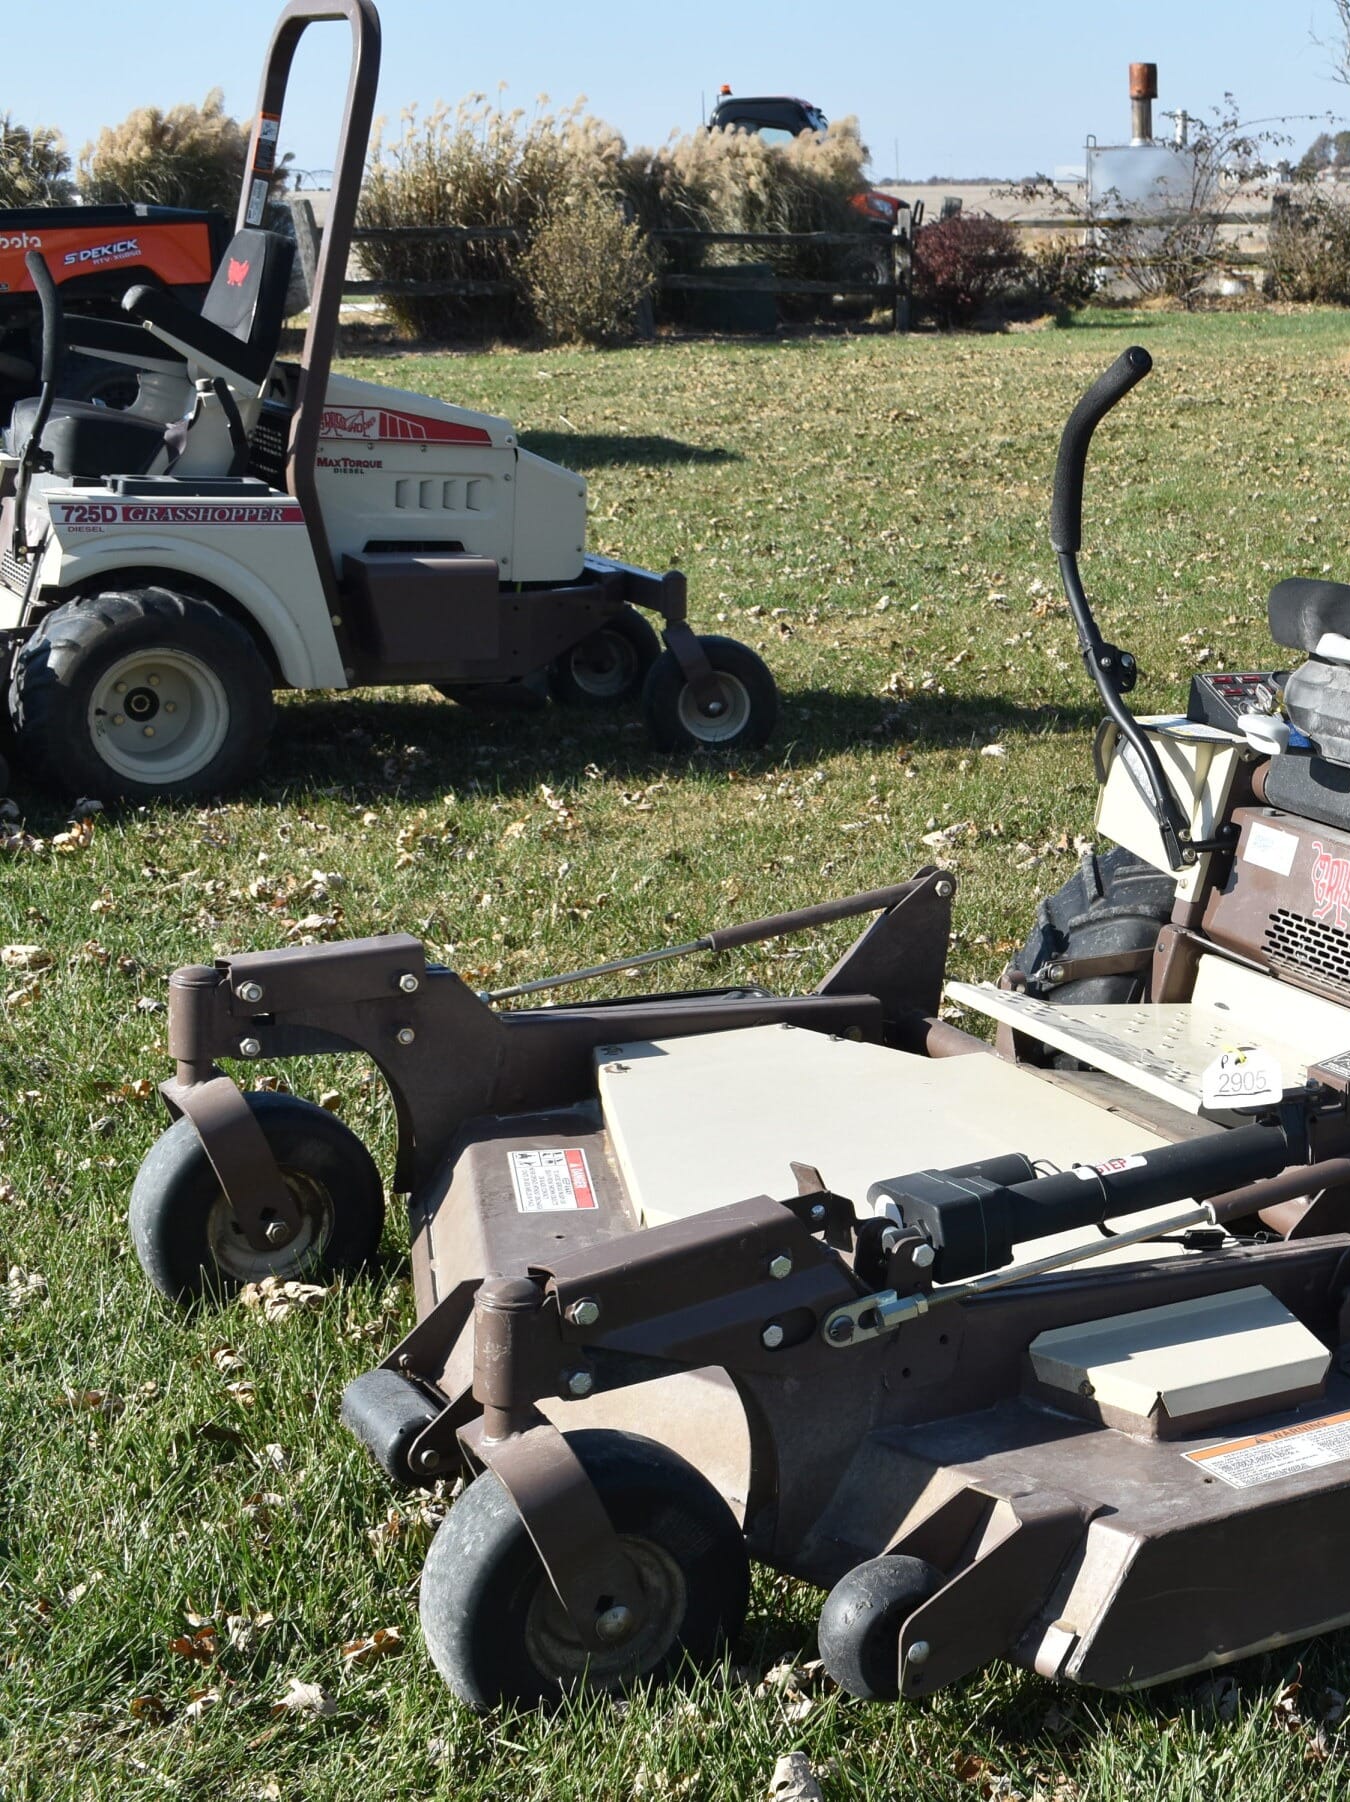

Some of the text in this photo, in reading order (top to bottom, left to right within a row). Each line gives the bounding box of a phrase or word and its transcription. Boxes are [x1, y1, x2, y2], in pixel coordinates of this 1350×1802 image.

[0, 232, 41, 249] bota
[64, 239, 138, 265] SDEKICK
[61, 505, 285, 522] 725D GRASSHOPPER
[1218, 1070, 1267, 1093] 2905
[1269, 1420, 1328, 1440] WARNING
